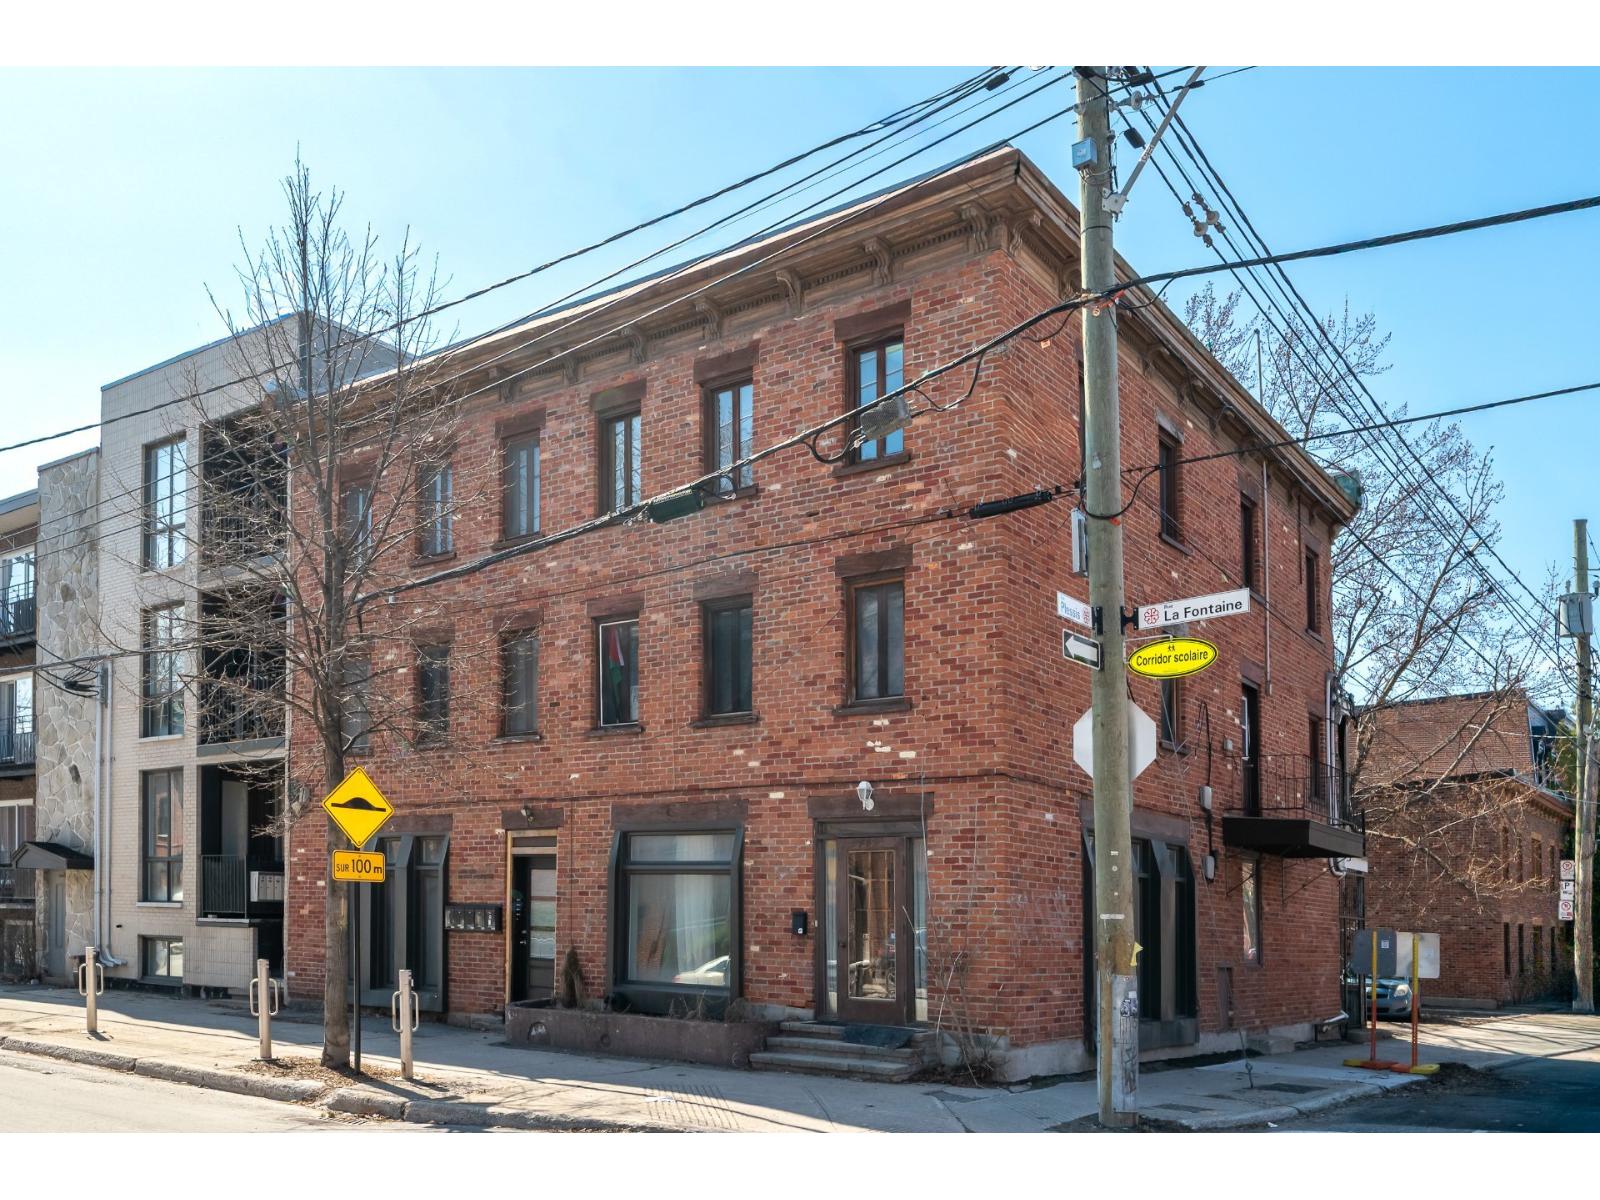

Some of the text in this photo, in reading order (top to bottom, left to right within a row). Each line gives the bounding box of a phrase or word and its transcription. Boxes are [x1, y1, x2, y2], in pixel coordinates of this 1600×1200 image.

[1164, 600, 1243, 622] La Fontaine
[1136, 649, 1209, 667] Corridor scolaire
[336, 859, 382, 874] SUR 100 m
